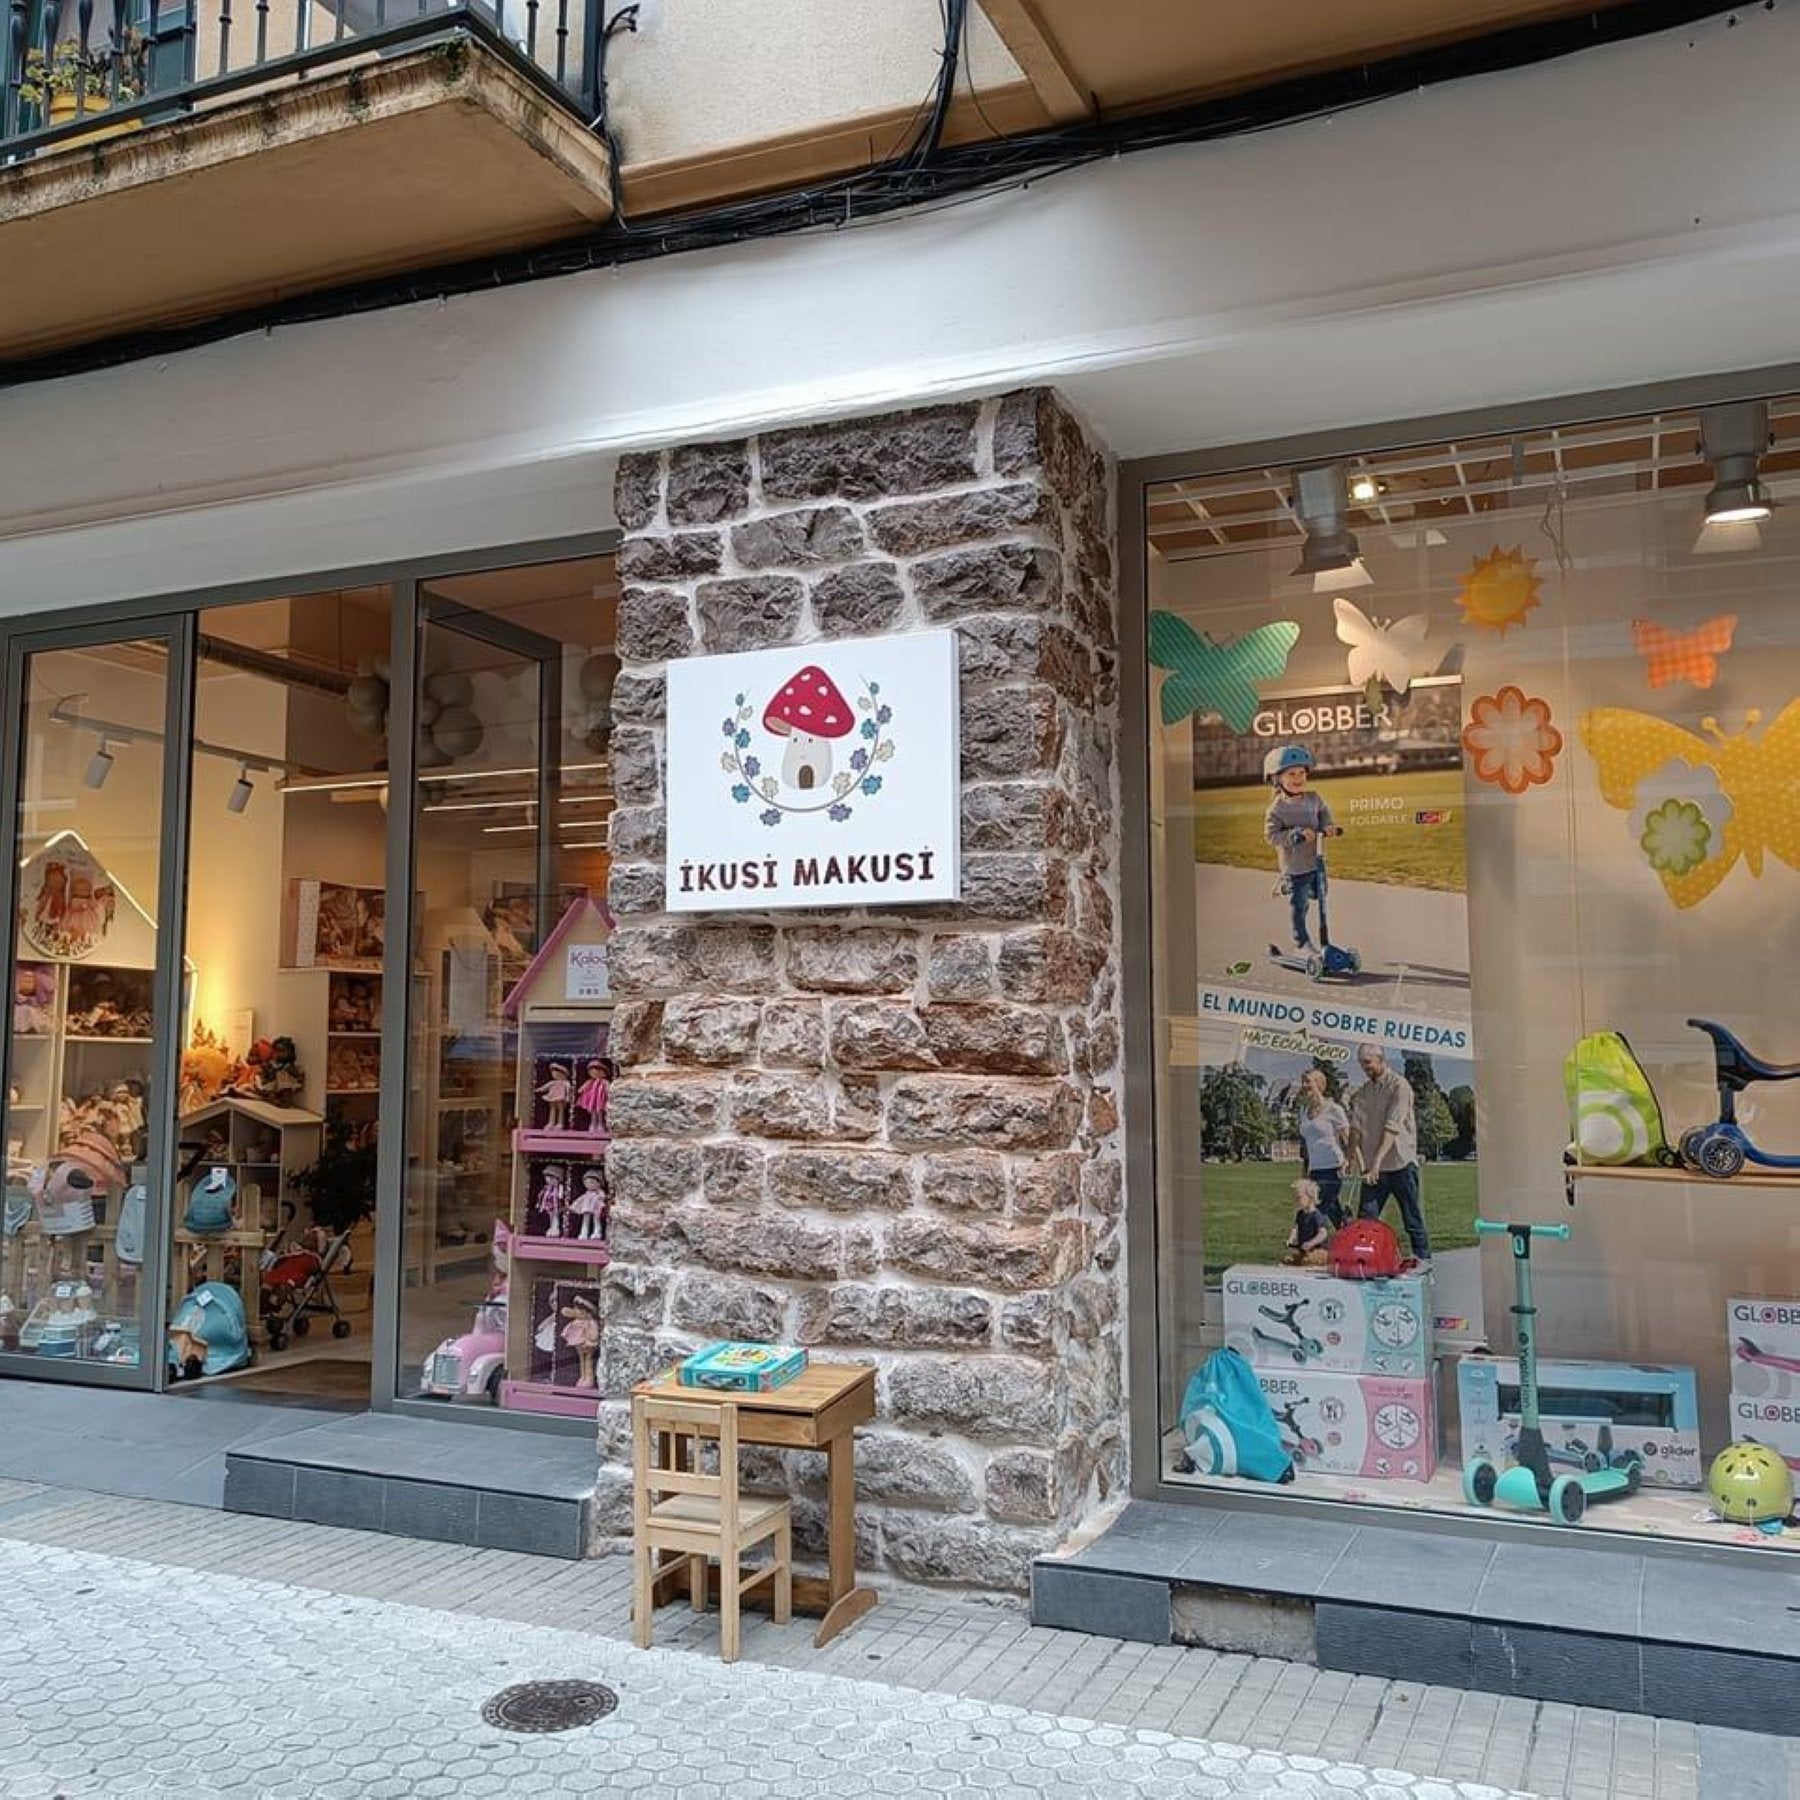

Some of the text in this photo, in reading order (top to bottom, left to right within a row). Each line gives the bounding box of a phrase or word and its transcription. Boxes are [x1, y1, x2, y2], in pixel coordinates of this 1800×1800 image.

[1349, 796, 1404, 812] PRIMO
[1202, 993, 1467, 1049] EL MUNDO SOBRE RUEDAS
[1226, 1280, 1300, 1297] GLOBBER
[1259, 1378, 1299, 1395] BBER
